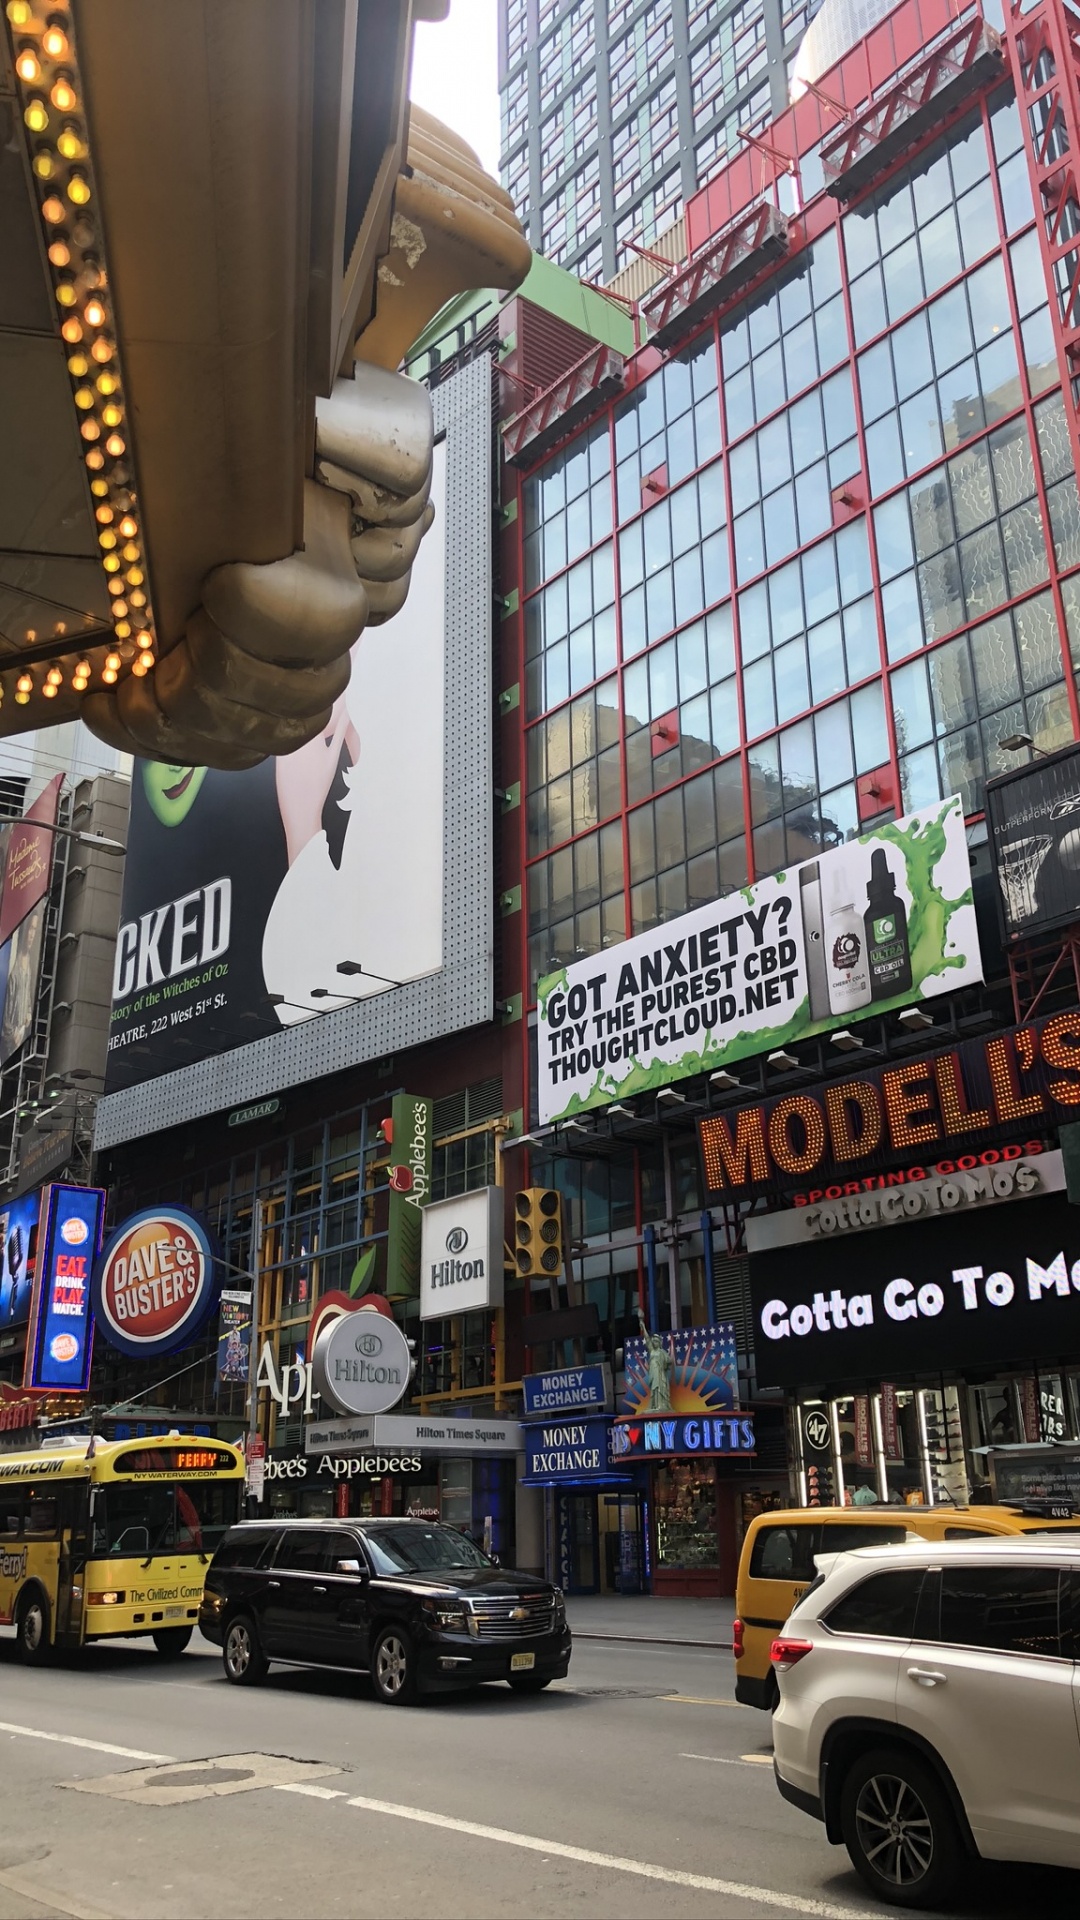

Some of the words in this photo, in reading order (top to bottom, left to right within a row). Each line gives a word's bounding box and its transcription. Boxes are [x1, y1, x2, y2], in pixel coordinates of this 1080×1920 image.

[547, 973, 608, 1028] GOT
[615, 896, 792, 1003] ANXIETY?
[872, 943, 903, 961] ULTRA
[875, 965, 890, 974] CBD
[891, 959, 904, 969] OIL
[111, 1004, 132, 1022] story
[134, 995, 145, 1012] of
[145, 991, 160, 1007] the
[163, 976, 200, 1000] Witches
[202, 968, 214, 984] of
[215, 963, 229, 977] Oz
[832, 978, 851, 988] CHERRY
[852, 973, 866, 982] COLA
[548, 1018, 588, 1057] TRY
[592, 1004, 639, 1041] THE
[641, 965, 738, 1022] PUREST
[743, 939, 798, 982] CBD
[150, 1016, 168, 1034] 222
[170, 1006, 193, 1026] West
[195, 997, 212, 1016] 51st
[214, 993, 228, 1011] St.
[548, 970, 800, 1085] THOUGHTCLOUD.NET
[235, 1103, 272, 1122] LAMAR
[700, 1012, 1080, 1192] MODELL'S
[404, 1102, 429, 1210] Applebee's
[793, 1165, 926, 1208] SPORTING
[935, 1139, 1044, 1175] GOODS
[926, 1181, 961, 1210] To
[56, 1254, 87, 1277] EAT.
[114, 1239, 174, 1292] DAVE
[174, 1236, 194, 1266] &
[431, 1258, 484, 1289] Hilton
[55, 1276, 86, 1289] DRINK.
[115, 1266, 196, 1320] BUSTER'S
[54, 1287, 84, 1303] PLAY.
[761, 1289, 874, 1340] Gotta
[883, 1278, 944, 1321] Go
[952, 1265, 1015, 1310] To
[52, 1303, 84, 1316] WATCH.
[223, 1304, 240, 1313] NEW
[334, 1359, 401, 1384] Hilton
[542, 1373, 583, 1391] MONEY
[533, 1387, 597, 1408] EXCHANGE
[860, 1398, 869, 1452] MODELL'S
[887, 1385, 896, 1443] MODELL'S
[416, 1427, 445, 1439] Hilton
[447, 1428, 473, 1439] Times
[474, 1429, 506, 1443] Square
[542, 1425, 588, 1448] MONEY
[644, 1421, 678, 1451] NY
[684, 1419, 756, 1449] GIFTS
[177, 1453, 217, 1468] FERRY
[532, 1449, 600, 1473] EXCHANGE
[1021, 1474, 1041, 1482] Some
[1042, 1473, 1066, 1483] places
[1051, 1507, 1070, 1517] 4V42
[130, 1590, 145, 1602] The
[147, 1587, 178, 1601] Civilized
